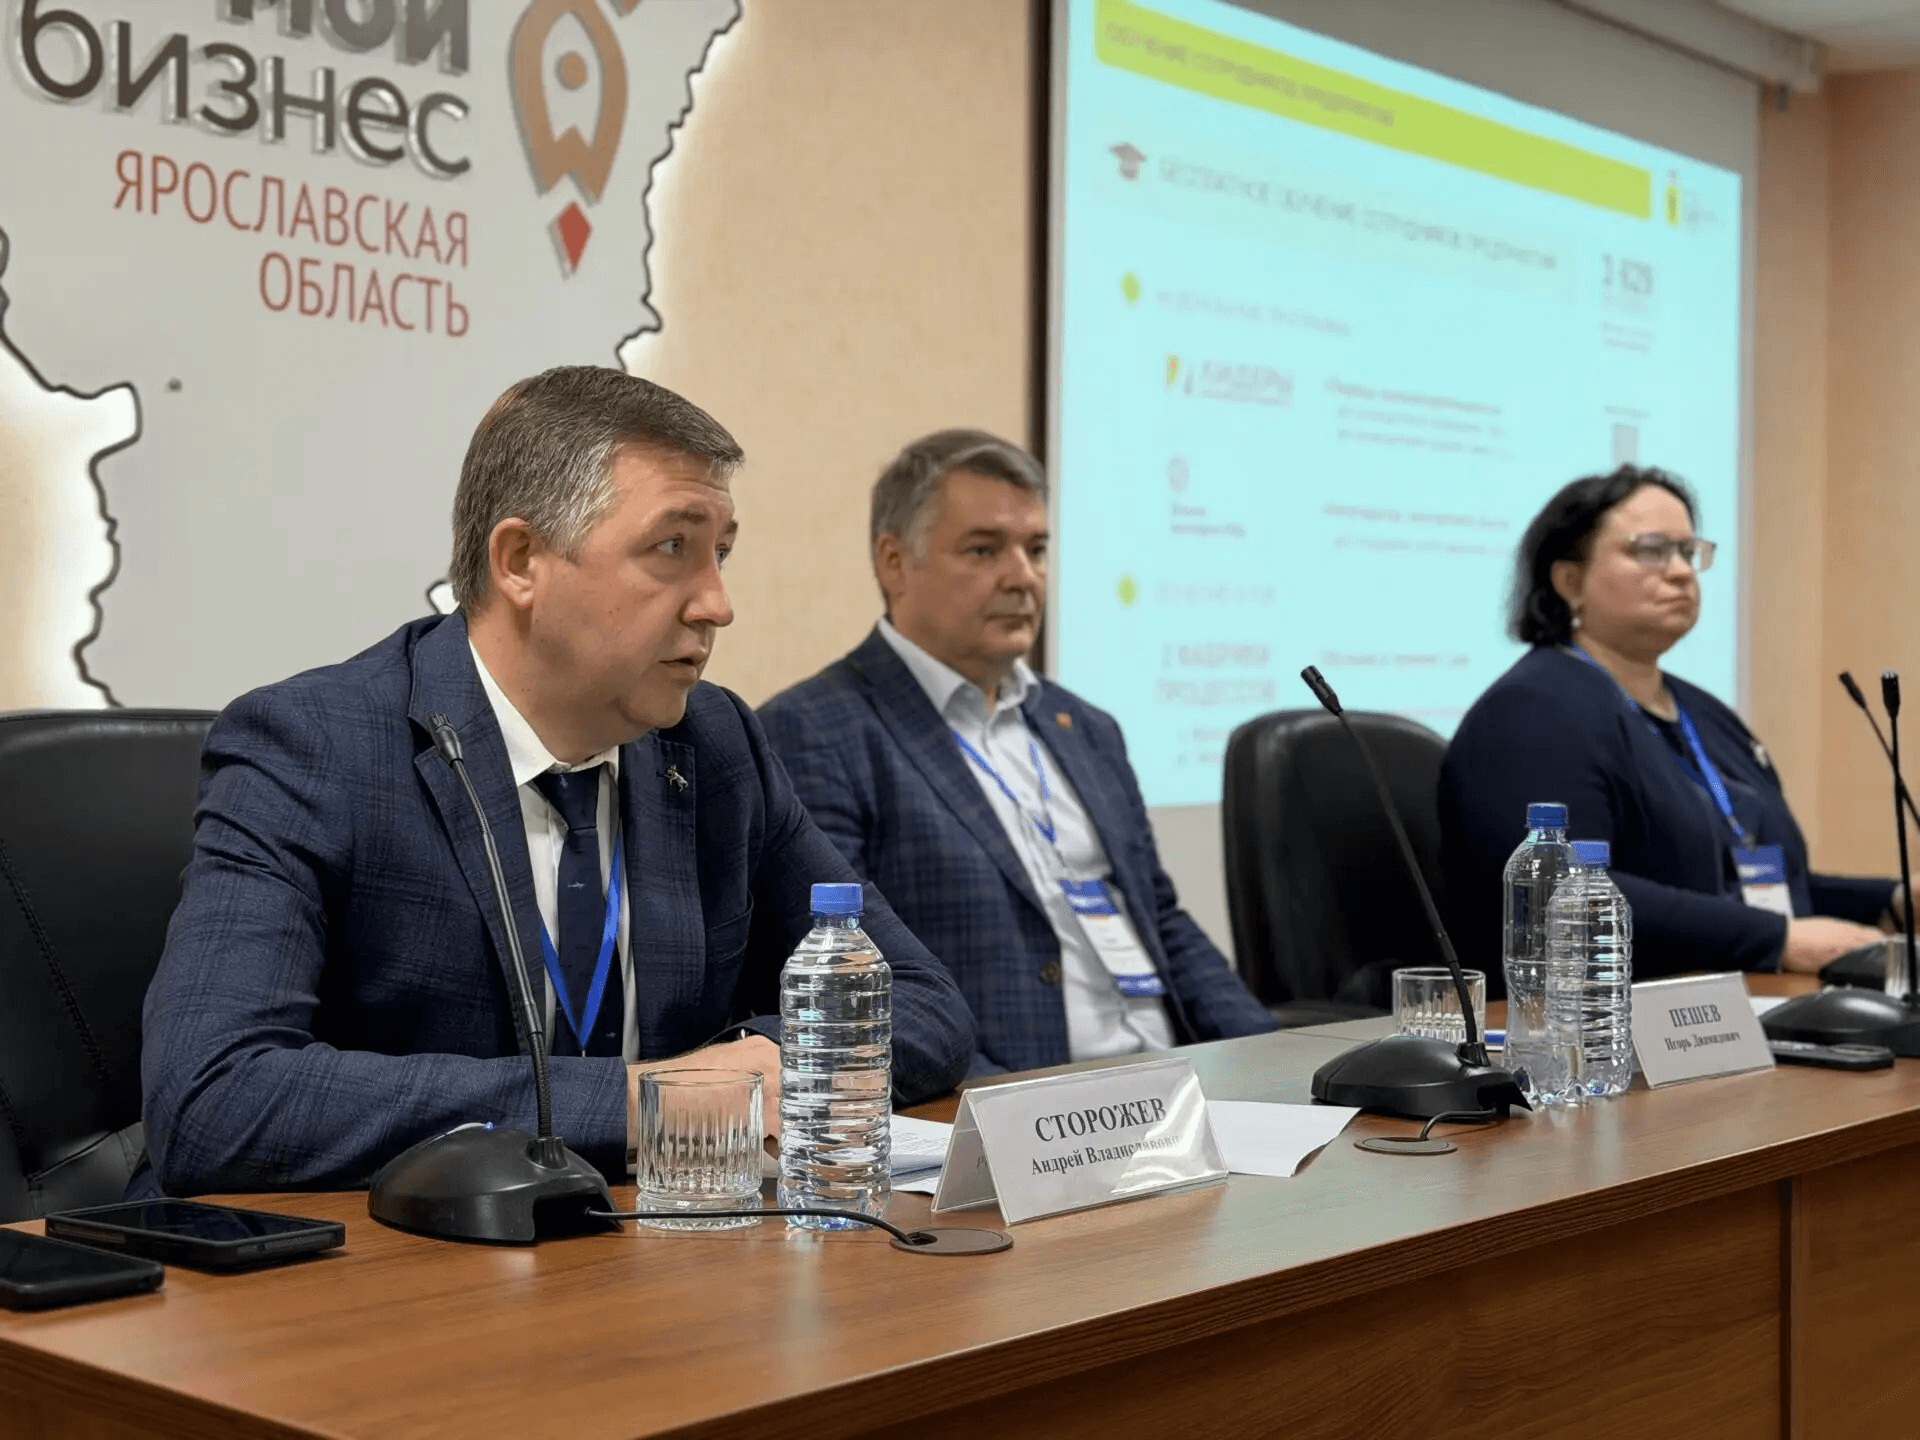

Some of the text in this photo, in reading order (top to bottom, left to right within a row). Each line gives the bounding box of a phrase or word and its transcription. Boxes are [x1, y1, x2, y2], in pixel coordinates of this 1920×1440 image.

[18, 0, 471, 177] бизнес
[113, 150, 470, 269] ЯРОСЛАВСКАЯ
[258, 251, 471, 338] ОБЛАСТЬ
[1668, 1003, 1722, 1028] ПЕШЕВ
[1664, 1036, 1692, 1053] Игорь
[1034, 1097, 1167, 1143] СТОРОЖЕВ
[1031, 1148, 1085, 1176] Андрей
